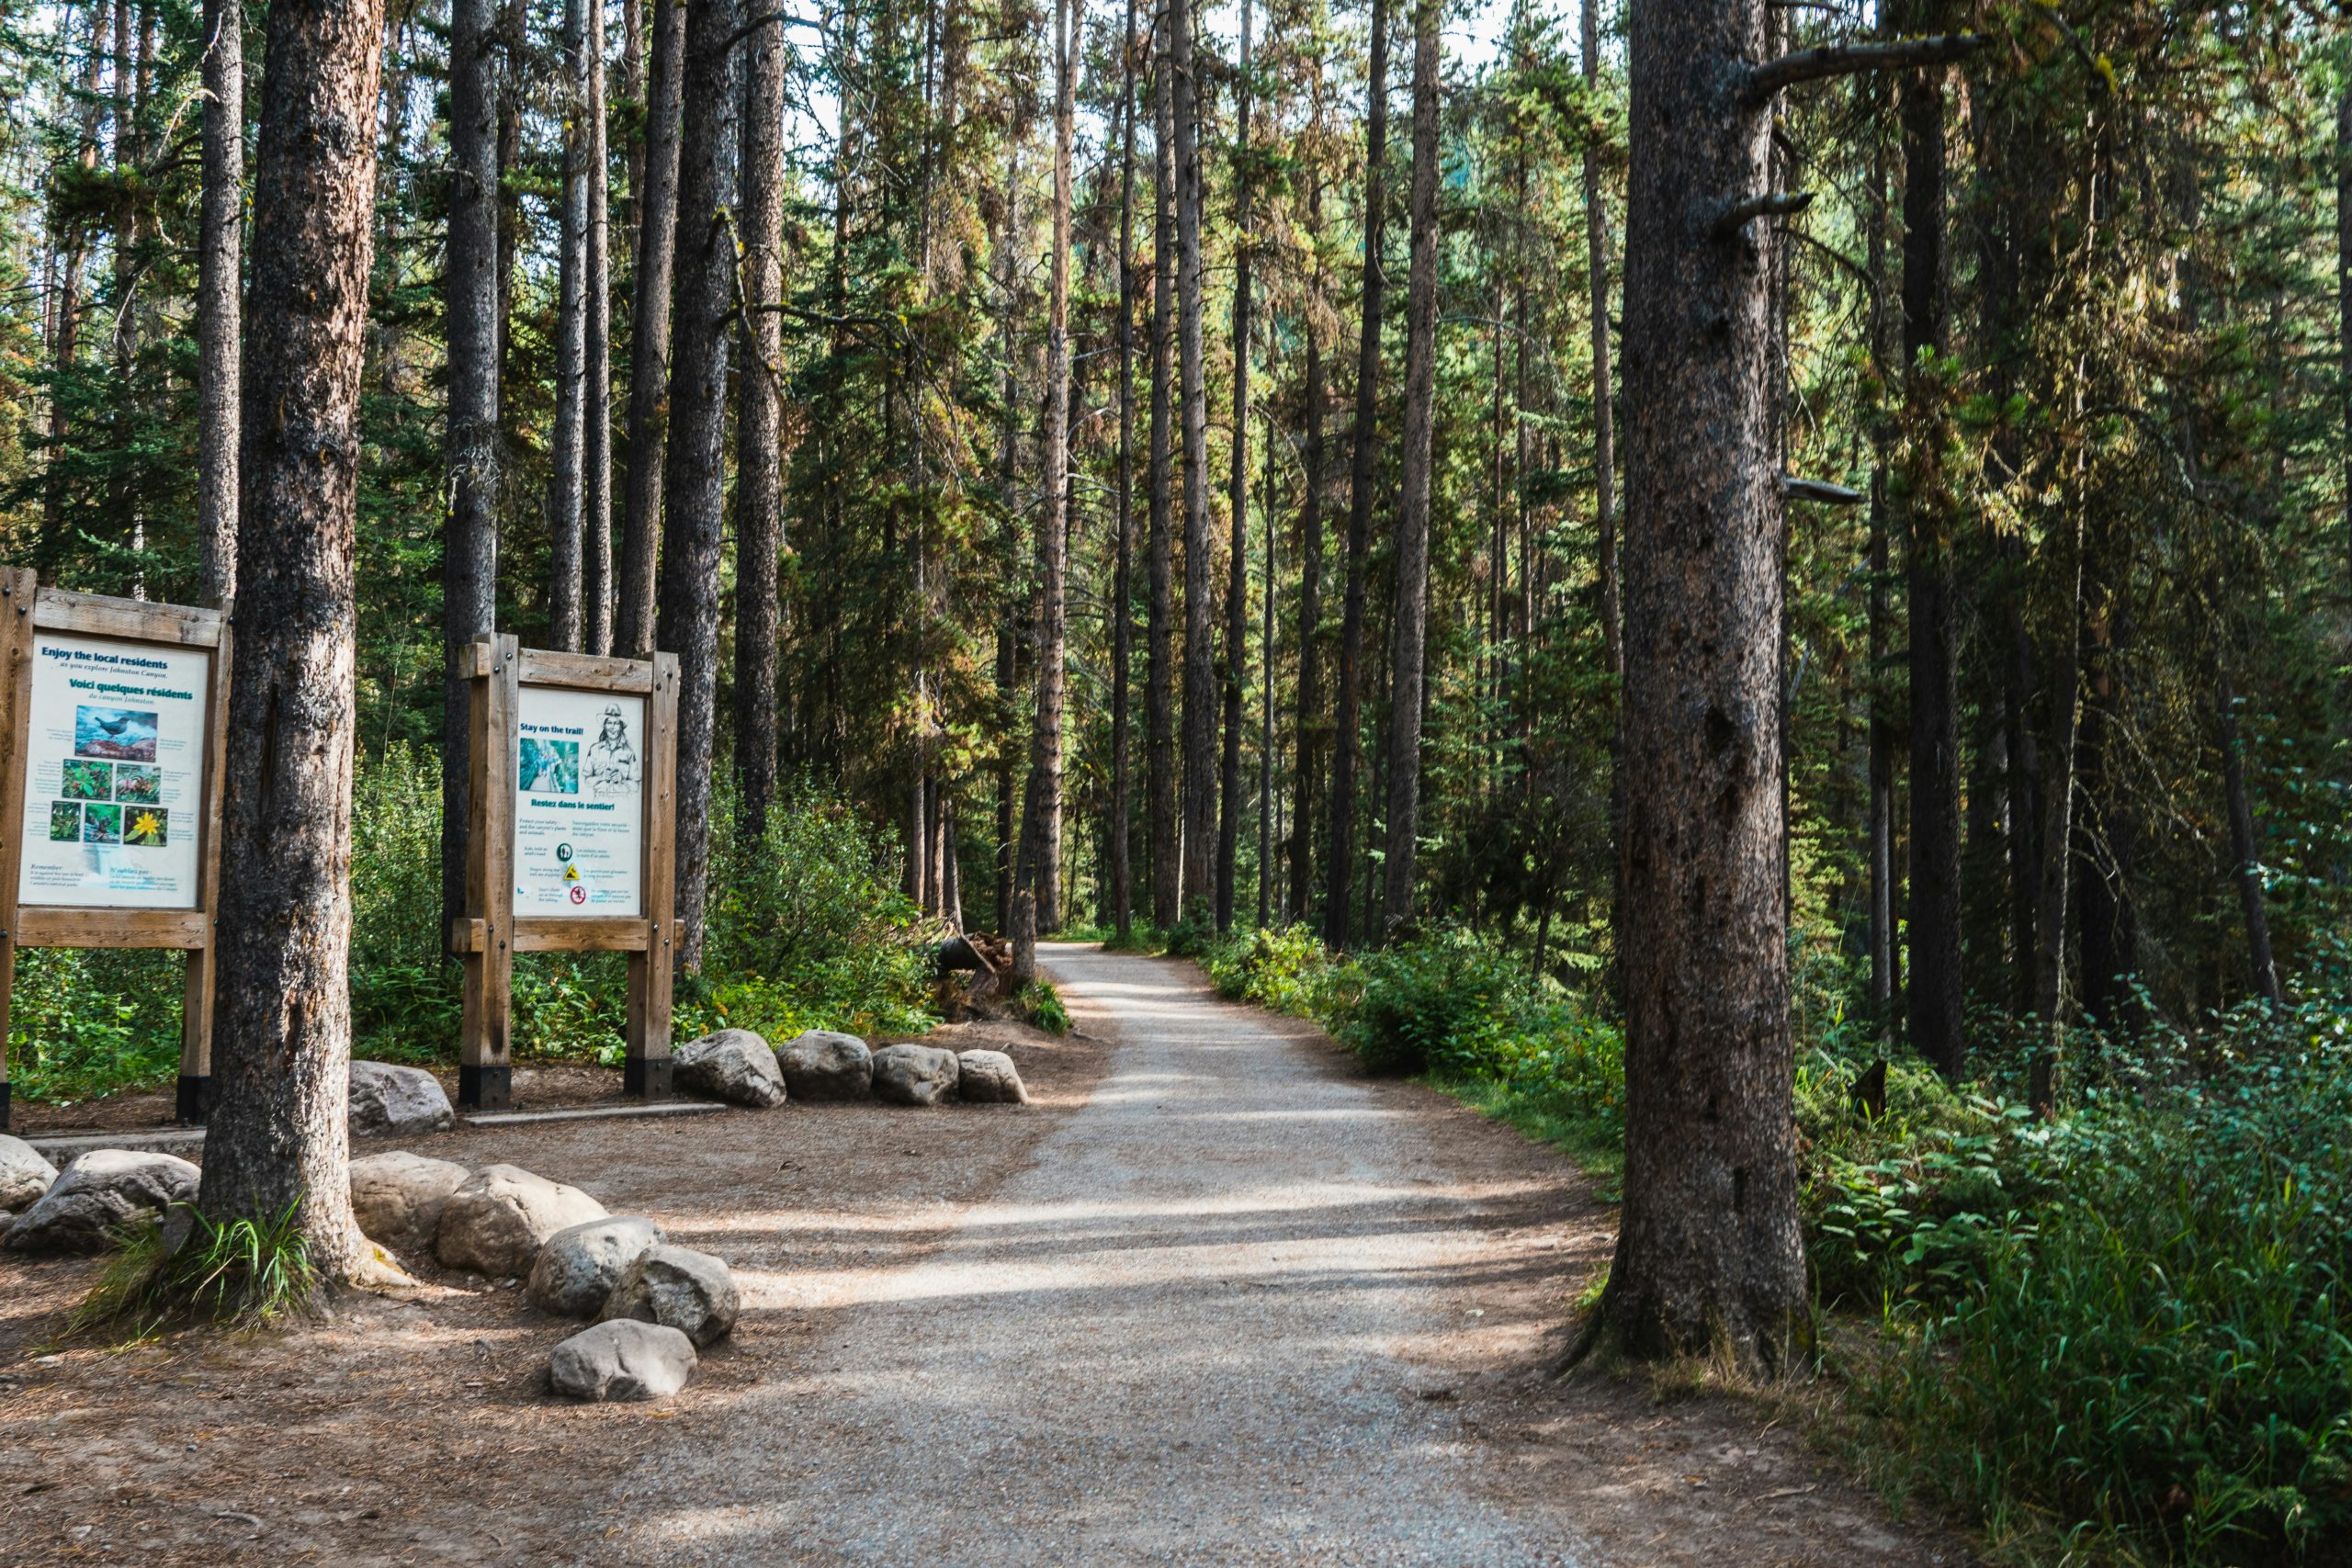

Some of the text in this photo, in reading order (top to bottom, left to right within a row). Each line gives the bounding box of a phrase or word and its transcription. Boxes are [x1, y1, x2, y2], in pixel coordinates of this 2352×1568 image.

[41, 647, 168, 670] Enjoy the local residents
[84, 663, 108, 672] explore
[109, 665, 140, 676] Johnston
[141, 669, 168, 680] Canyon.
[69, 679, 193, 700] Voici quelques résidents
[520, 723, 537, 733] Stay
[550, 725, 564, 734] the
[565, 727, 583, 736] trail!
[531, 798, 615, 811] Restez dans le sentier!
